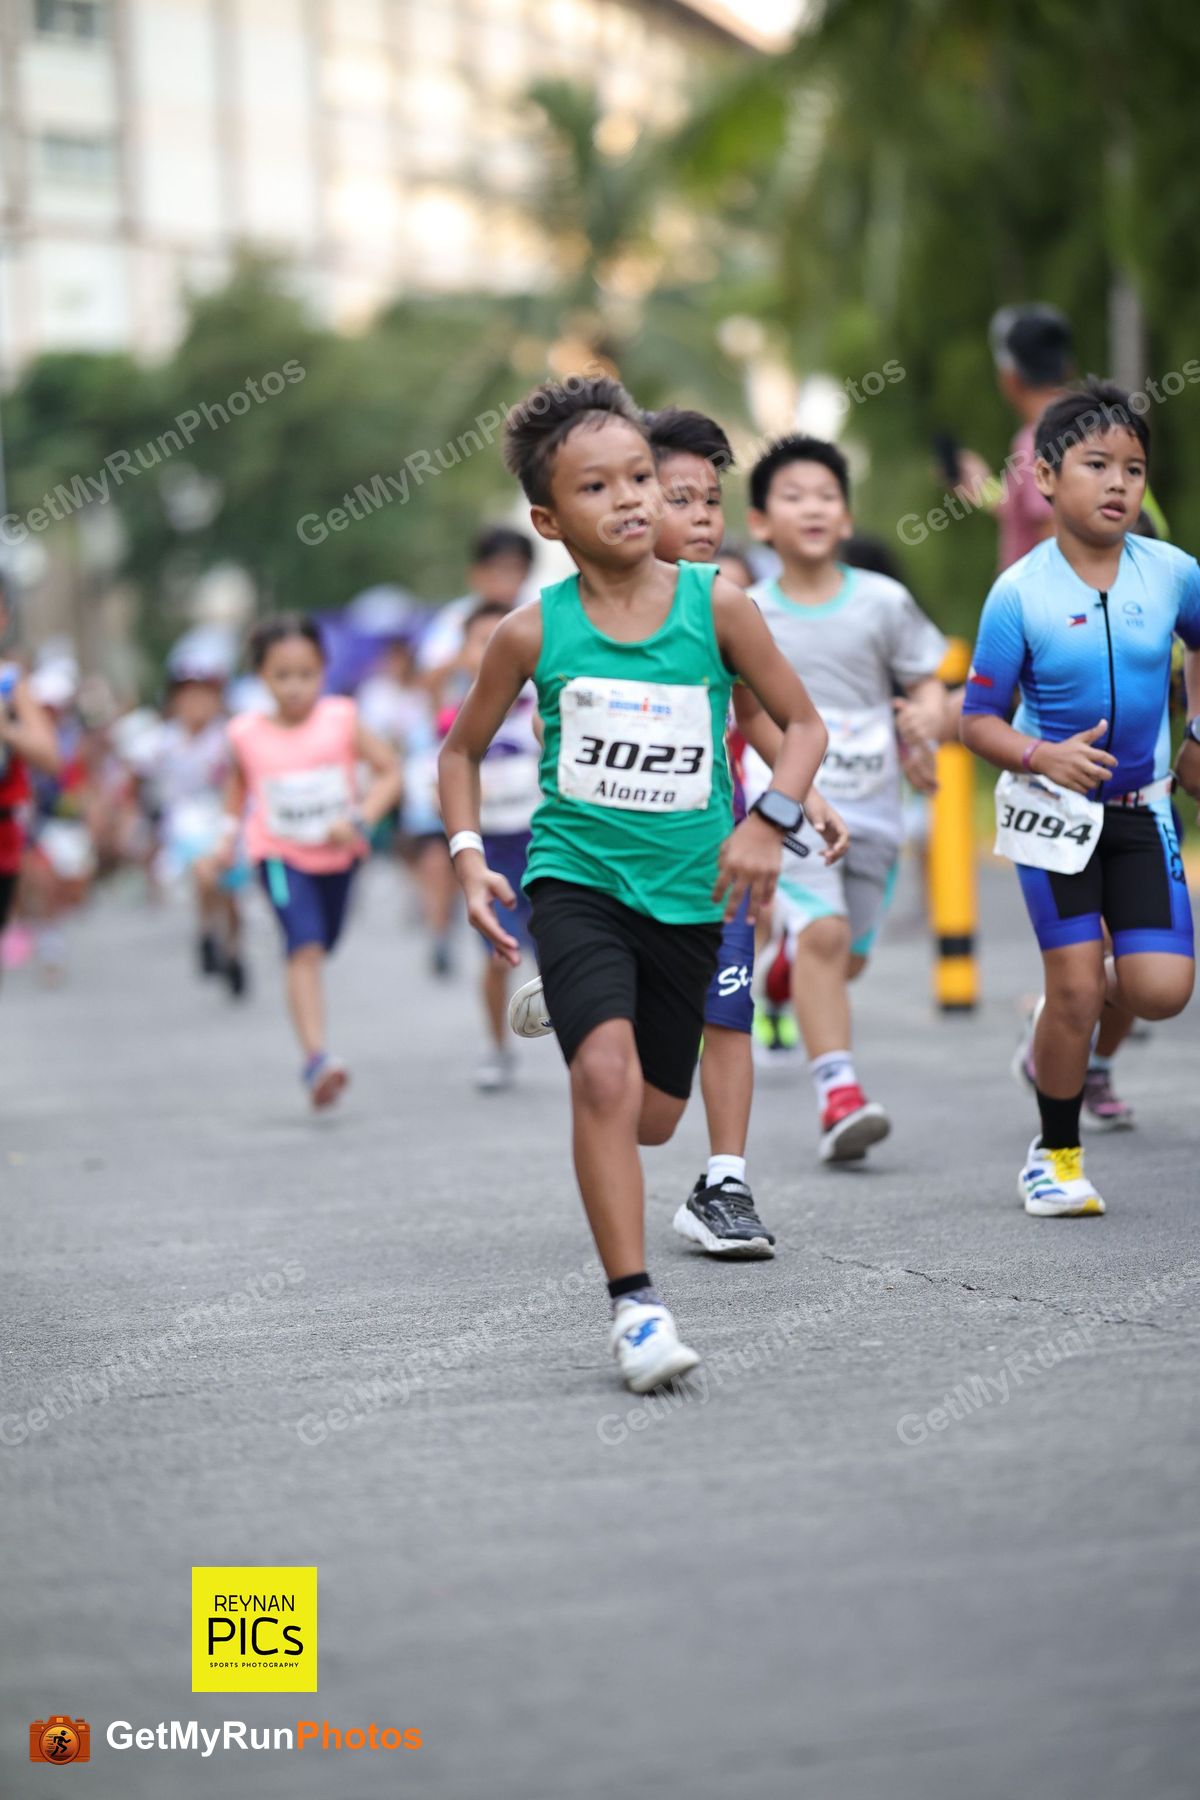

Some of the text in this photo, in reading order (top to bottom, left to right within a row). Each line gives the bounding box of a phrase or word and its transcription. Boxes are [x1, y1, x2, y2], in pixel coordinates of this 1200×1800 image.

[575, 736, 705, 774] 3023
[594, 778, 678, 804] Alonzo
[1000, 804, 1093, 846] 3094
